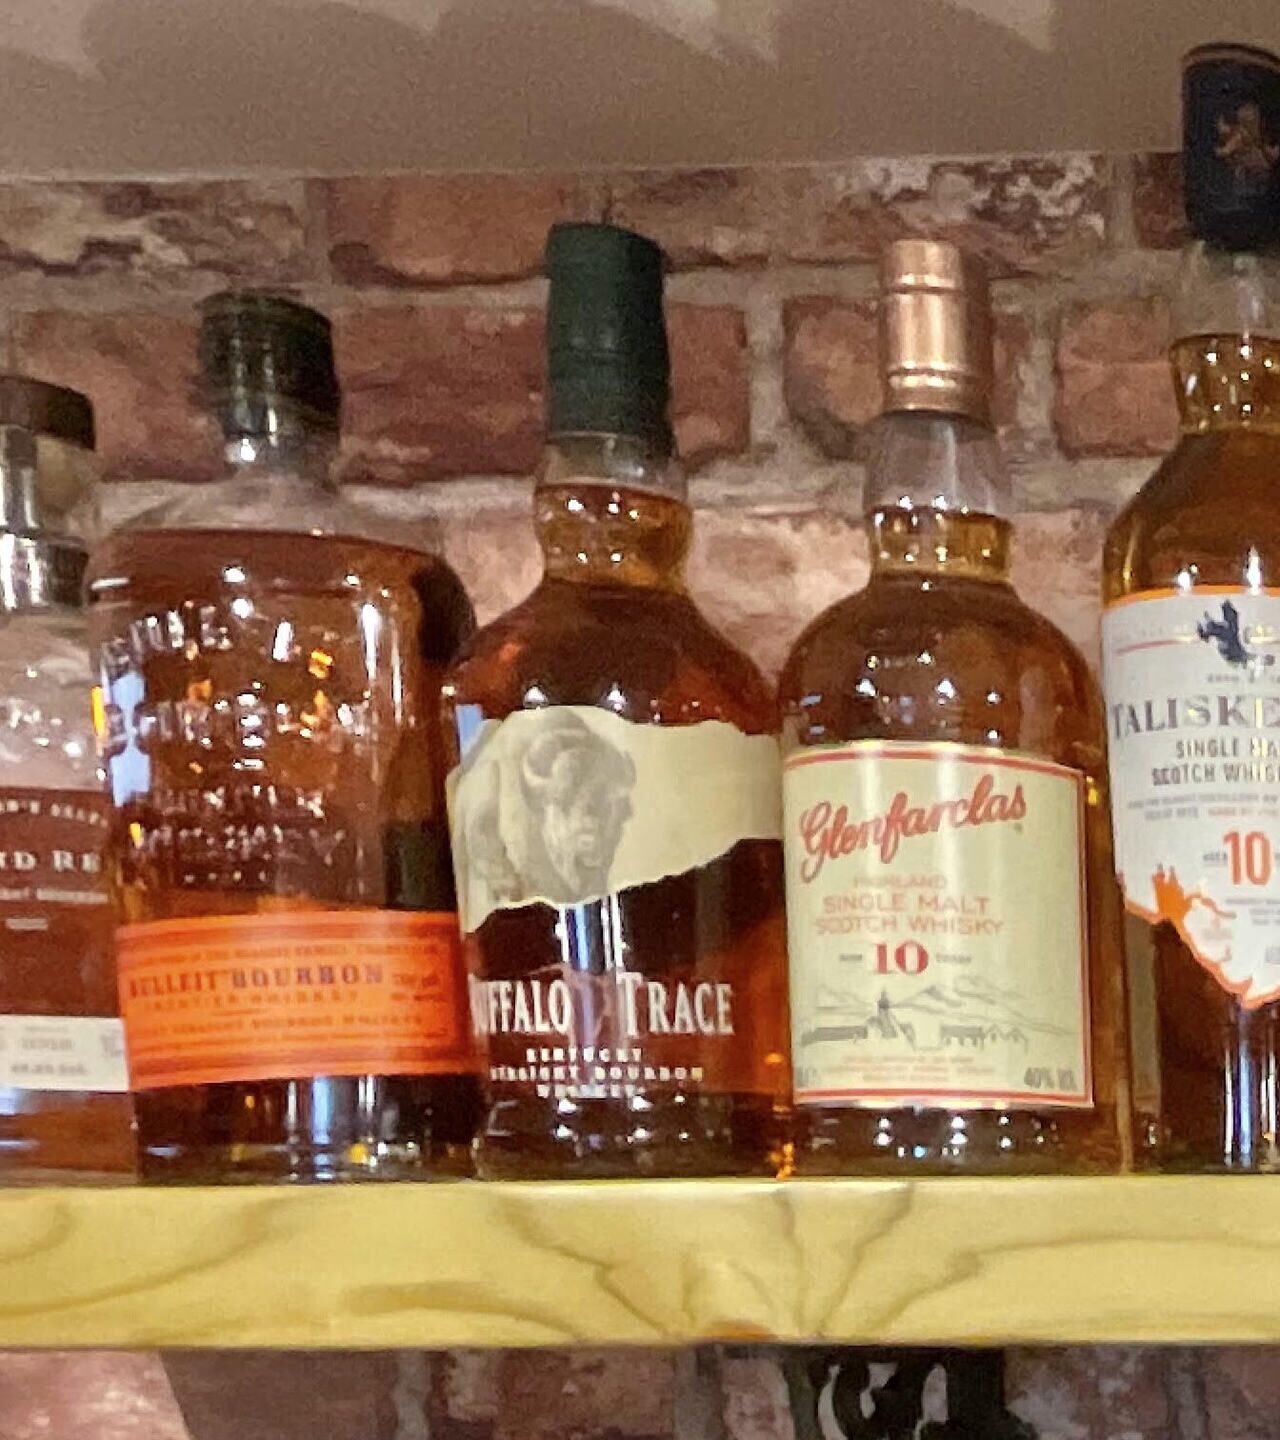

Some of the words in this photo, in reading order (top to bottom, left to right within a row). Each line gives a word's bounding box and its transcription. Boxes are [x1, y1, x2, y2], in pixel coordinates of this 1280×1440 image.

[1175, 738, 1240, 760] SINGLE
[1152, 763, 1216, 787] SCOTCH
[800, 774, 1027, 884] Glenfarclas
[1223, 830, 1273, 886] 10
[823, 894, 909, 914] SINGLE
[918, 896, 991, 914] MALT
[815, 915, 898, 936] SCOTCH
[907, 915, 1005, 936] WHISKY
[874, 938, 930, 975] 10
[232, 962, 384, 990] BOURBON
[467, 972, 572, 1038] UFFALO
[615, 971, 735, 1039] TRACE
